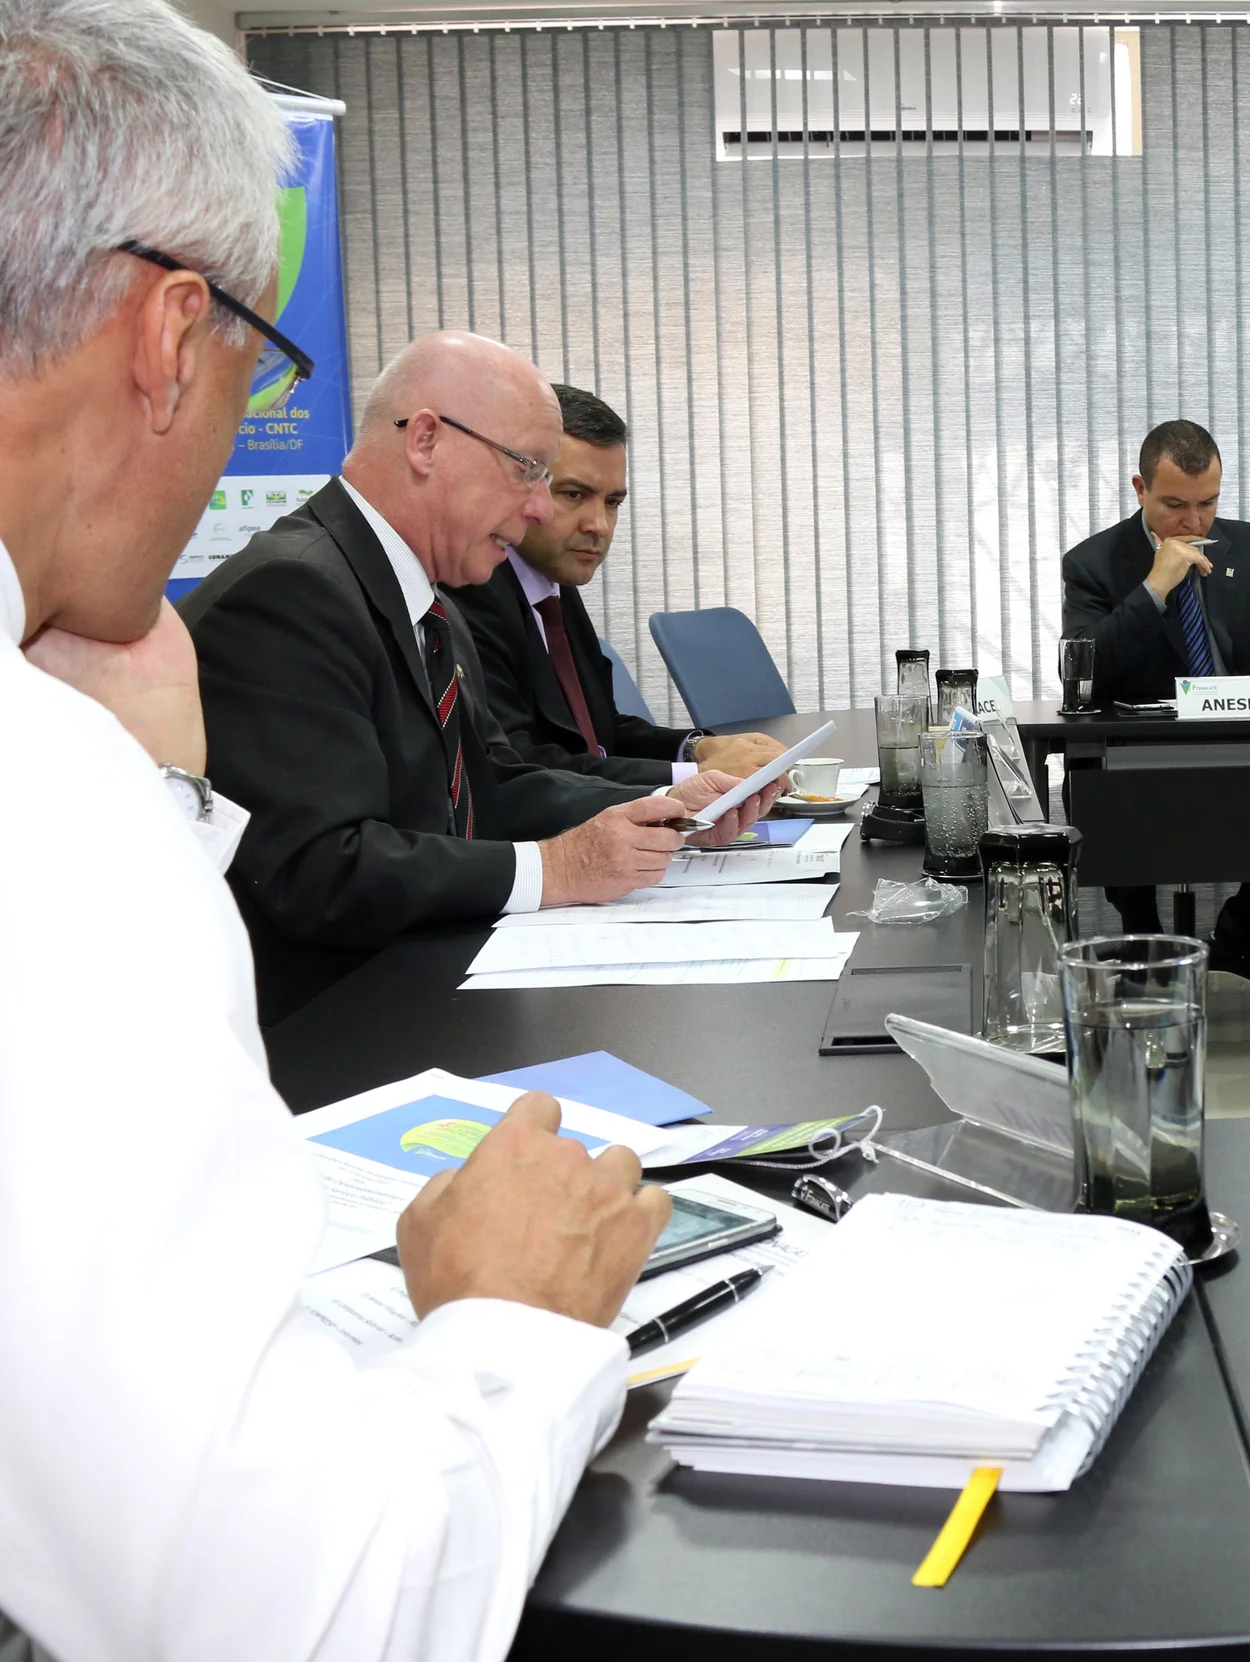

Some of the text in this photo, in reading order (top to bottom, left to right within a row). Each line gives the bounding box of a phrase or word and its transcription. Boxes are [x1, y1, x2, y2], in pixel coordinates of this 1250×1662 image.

[244, 407, 310, 419] acional dos
[239, 422, 255, 434] cio
[265, 422, 298, 434] CNTC
